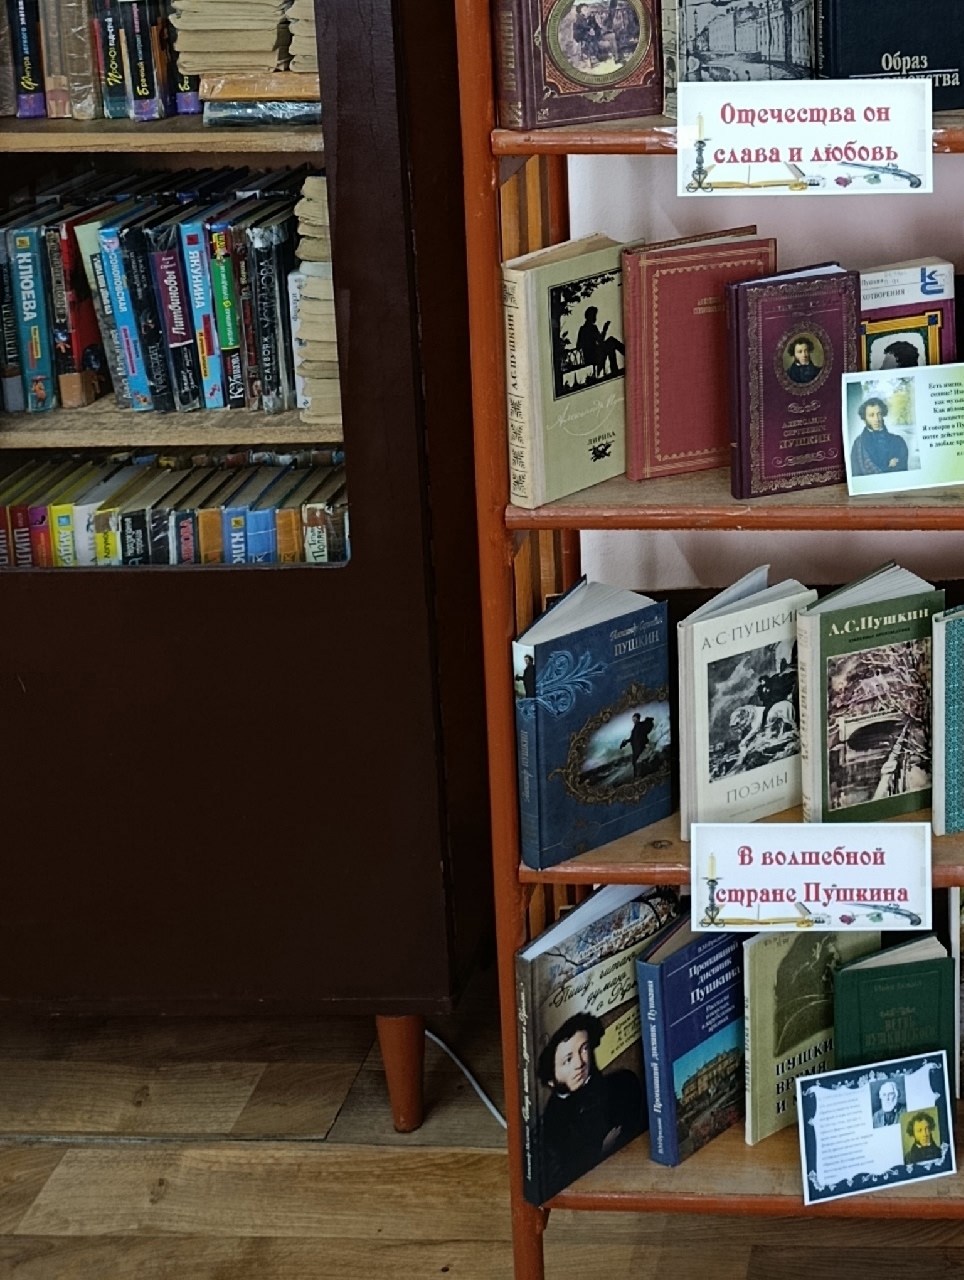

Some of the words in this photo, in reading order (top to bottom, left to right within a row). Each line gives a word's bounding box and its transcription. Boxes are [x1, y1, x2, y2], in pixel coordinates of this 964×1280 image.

[136, 61, 149, 96] Брачный
[881, 51, 928, 73] Образ
[719, 102, 855, 125] Отечества
[864, 106, 890, 123] он
[713, 147, 781, 164] слава
[790, 146, 803, 162] и
[810, 141, 898, 162] любовь
[16, 251, 37, 322] КЛЮЕВА
[108, 249, 128, 313] СОКОЛОВСКАЯ
[189, 250, 205, 308] ЯКУНИНА
[163, 270, 187, 336] Литвиновы
[507, 309, 518, 362] ПУШКИН
[262, 335, 272, 381] САКВОЯЖ
[587, 431, 616, 446] ЛИРИКА
[779, 432, 832, 451] ПУШКИН
[614, 630, 660, 657] ПУШКИН
[726, 771, 789, 804] ПОЭМЫ
[737, 845, 753, 866] В
[761, 845, 886, 866] волшебной
[715, 884, 797, 907] стране
[803, 882, 909, 906] Пушкина
[690, 965, 741, 1005] Пушкина
